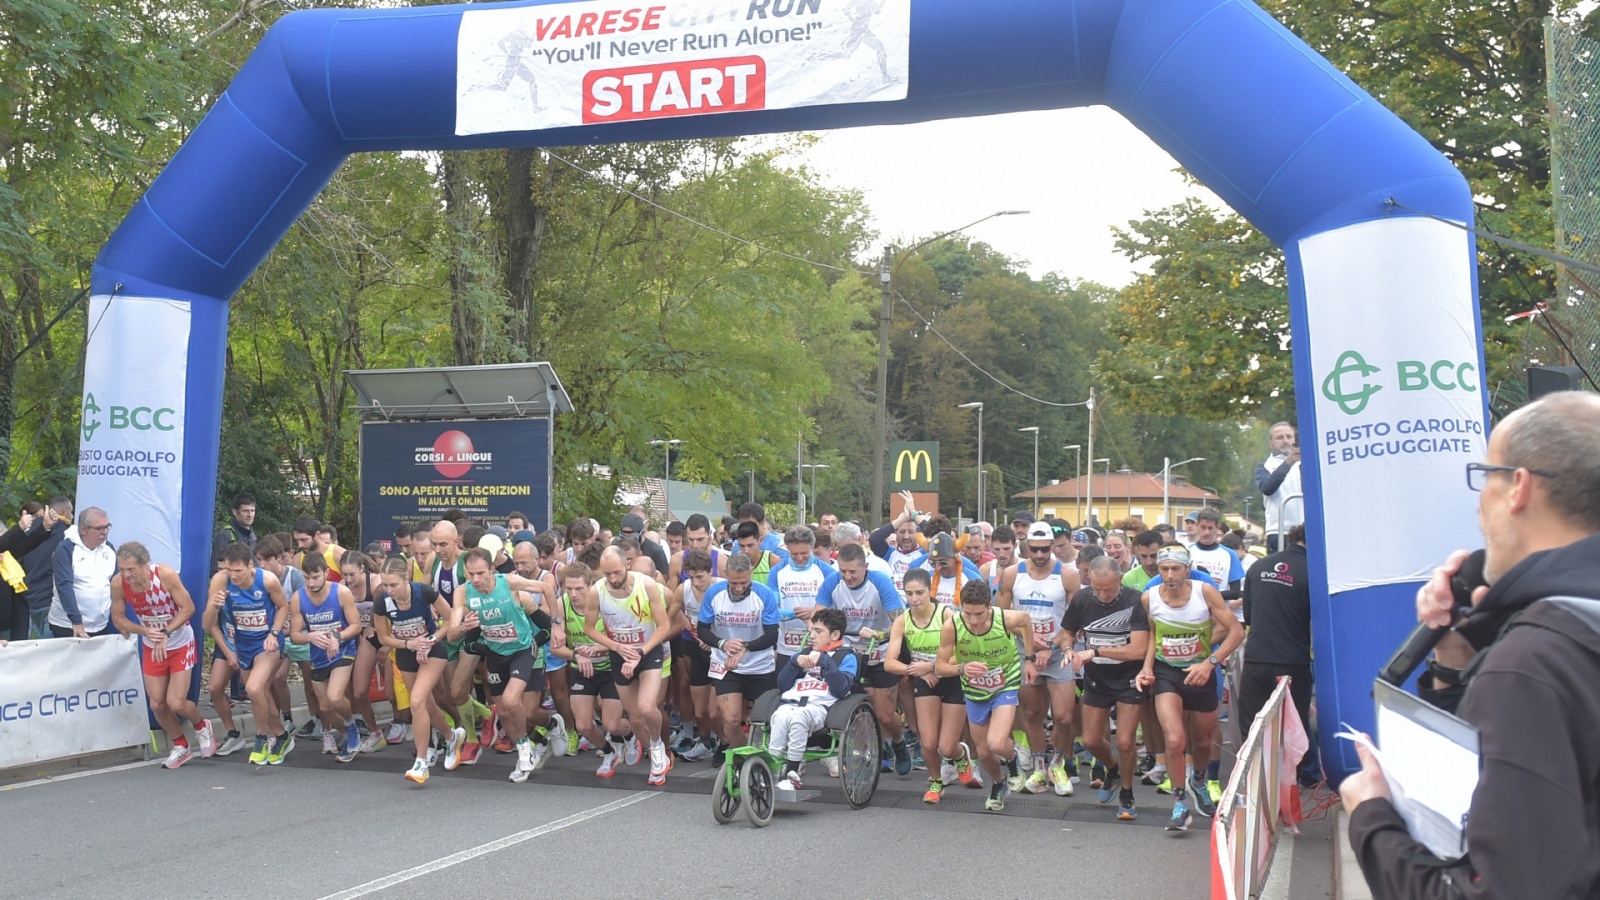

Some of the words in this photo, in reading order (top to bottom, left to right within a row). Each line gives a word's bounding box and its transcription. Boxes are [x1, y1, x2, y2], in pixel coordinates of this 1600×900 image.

[535, 5, 666, 41] VARESE
[746, 0, 823, 21] RUN
[609, 36, 678, 58] Never
[683, 32, 728, 51] Run
[590, 63, 757, 117] START
[1397, 360, 1477, 392] BCC
[109, 405, 176, 431] BCC
[1326, 421, 1391, 446] BUSTO
[1396, 418, 1482, 436] GAROLFO
[105, 450, 176, 463] GAROLFO
[414, 453, 444, 462] CORSI
[457, 452, 492, 462] LINGUE
[1327, 450, 1337, 465] E
[1342, 438, 1471, 462] BUGUGGIATE
[81, 465, 159, 477] BUGUGGIATE
[380, 485, 411, 496] SONO
[412, 485, 452, 496] APERTE
[456, 485, 469, 496] LE
[471, 485, 531, 496] ISCRIZIONI
[418, 497, 427, 506] IN
[428, 497, 450, 506] AULA
[450, 497, 456, 506] E
[457, 497, 488, 506] ONLINE
[236, 615, 266, 626] 2042
[395, 627, 426, 637] 2006
[484, 628, 515, 637] 2002
[612, 632, 640, 643] 2018
[1167, 643, 1197, 656] 2187
[799, 681, 823, 691] 3272
[969, 674, 1002, 687] 2003
[39, 693, 80, 717] Che
[85, 688, 139, 711] Corre
